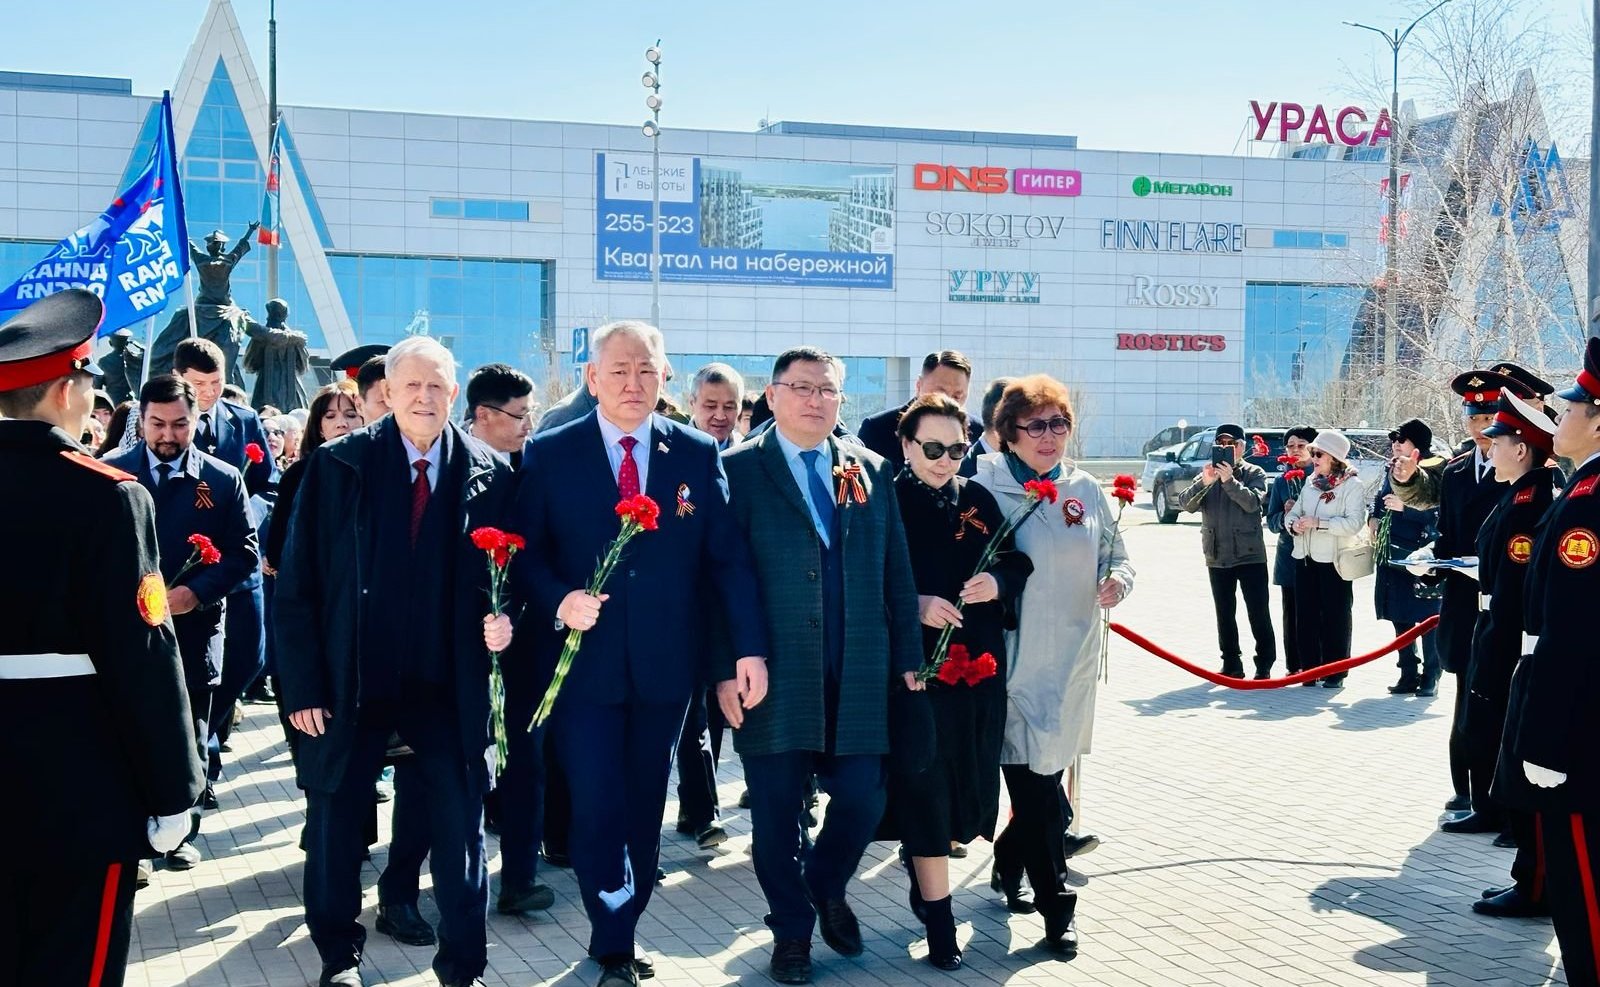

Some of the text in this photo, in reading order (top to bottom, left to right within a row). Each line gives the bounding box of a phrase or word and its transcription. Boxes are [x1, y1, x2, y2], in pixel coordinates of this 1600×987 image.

[1250, 100, 1392, 146] УРАСА
[636, 180, 686, 191] ВЫОТЫ
[914, 163, 1076, 194] DNS ГИПЕР
[605, 213, 694, 234] 255-523
[925, 211, 1065, 239] SOKOLOV
[1102, 219, 1243, 252] FINN FLARE
[604, 246, 887, 276] Квартал на набережной
[1117, 333, 1226, 351] ROSTIC'S
